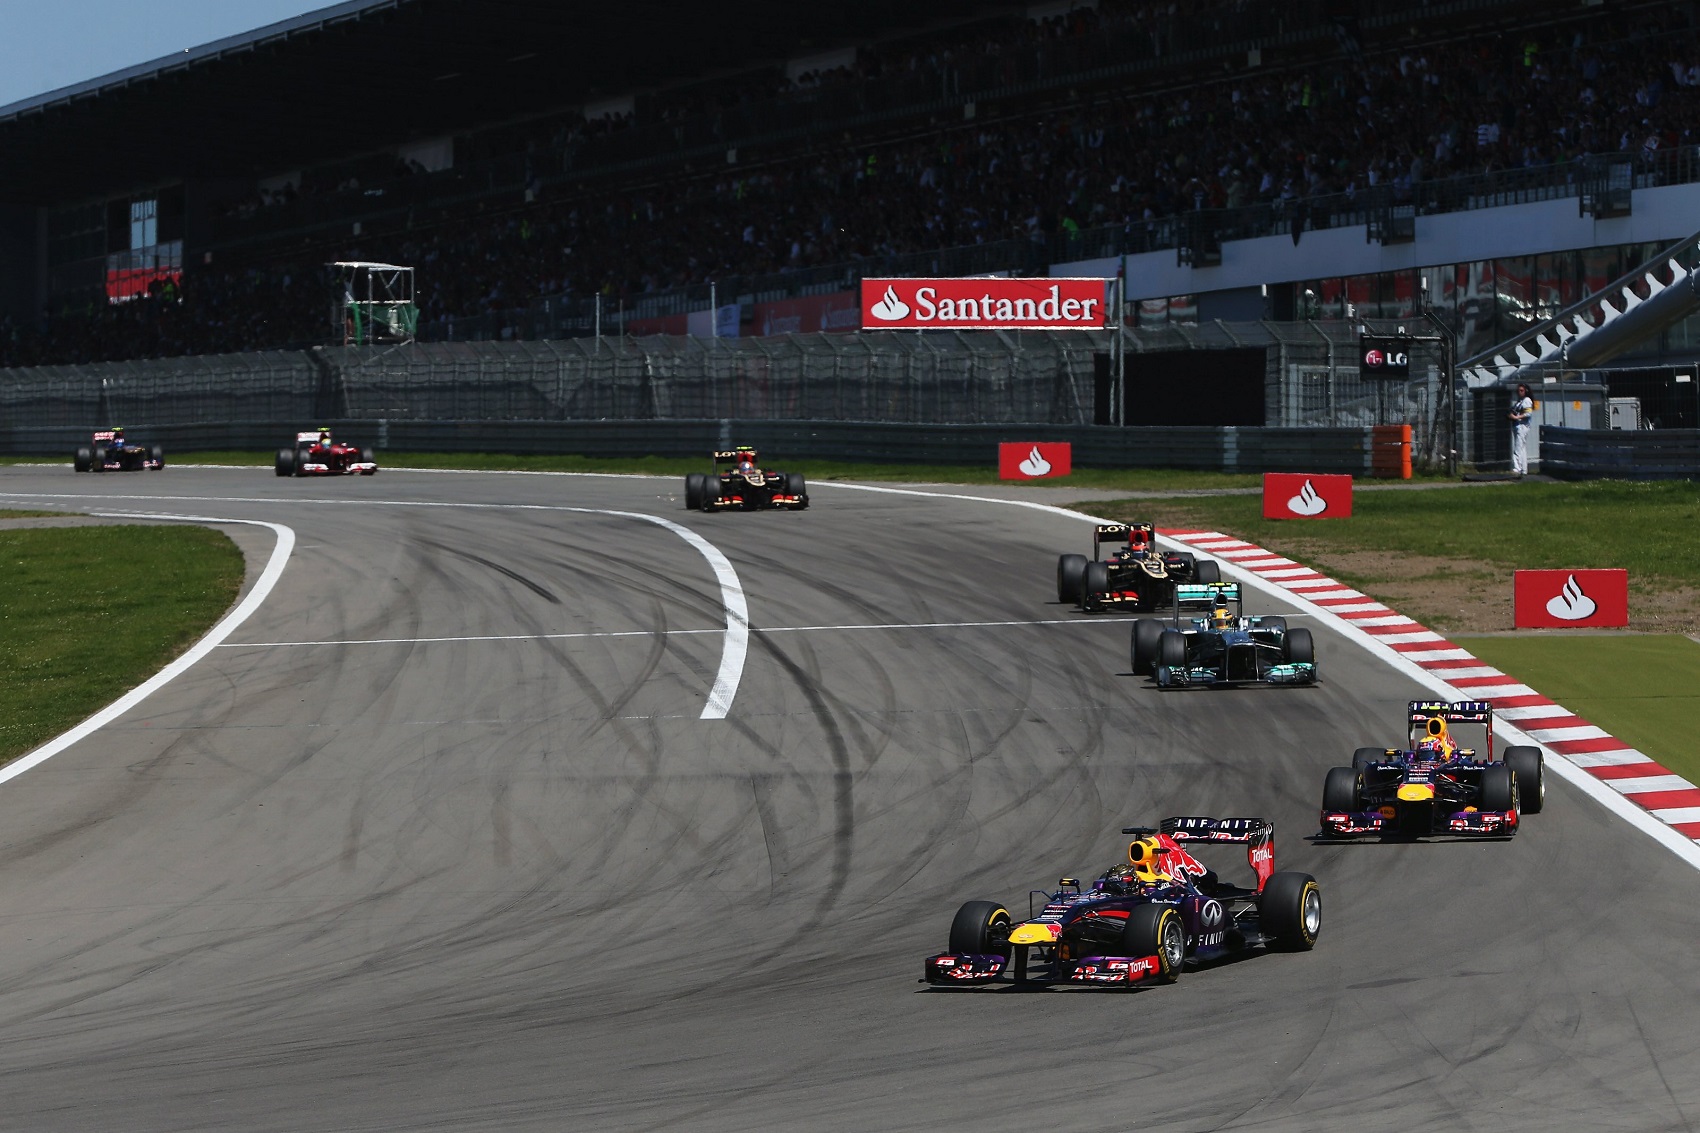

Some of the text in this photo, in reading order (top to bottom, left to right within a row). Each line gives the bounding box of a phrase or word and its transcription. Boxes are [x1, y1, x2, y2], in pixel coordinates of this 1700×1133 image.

[915, 285, 1098, 321] Santander
[1386, 352, 1408, 366] LG
[714, 450, 757, 458] LOS
[1177, 818, 1260, 829] INFNIT
[1252, 848, 1273, 863] TOTAL
[1129, 959, 1153, 973] TOTAL
